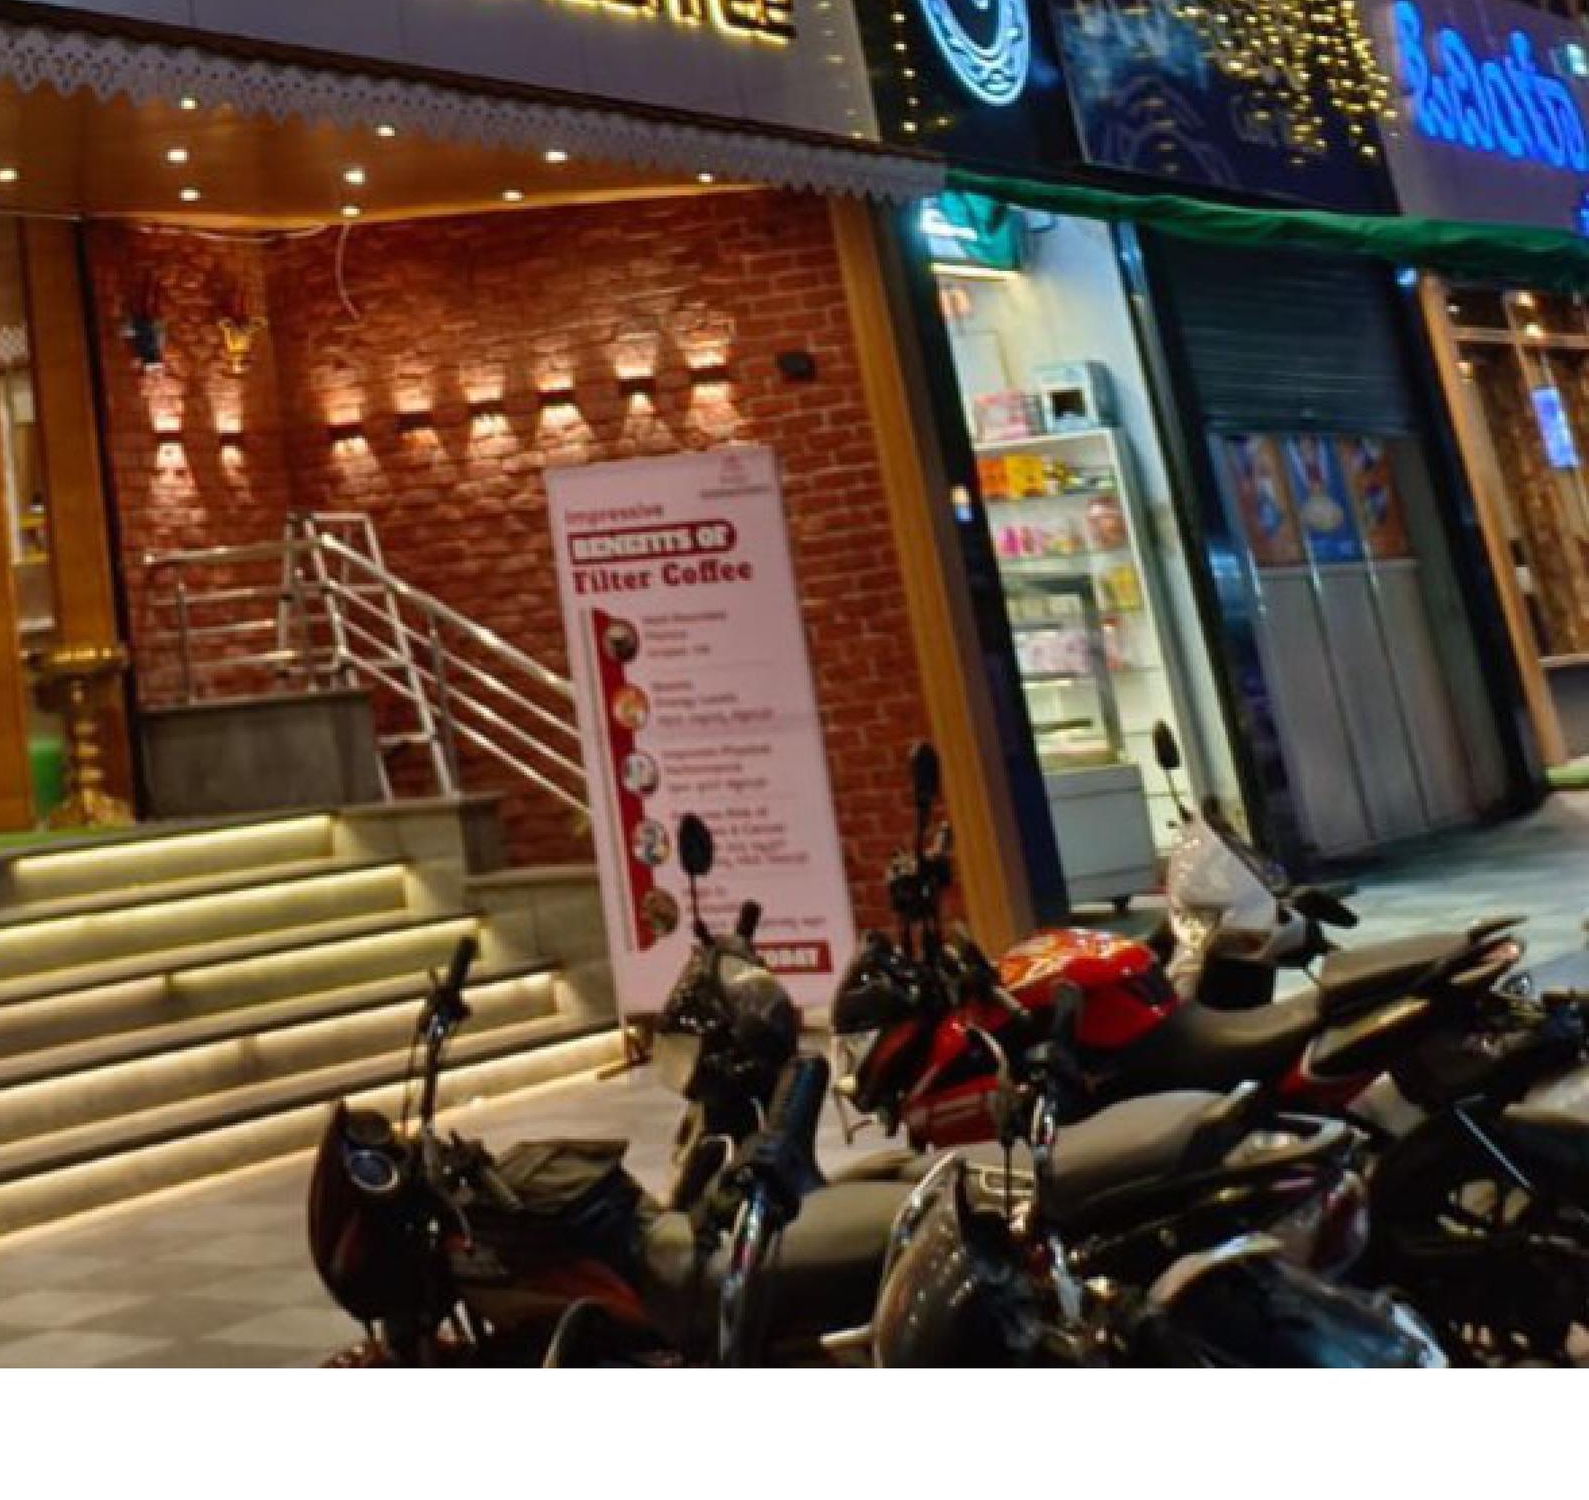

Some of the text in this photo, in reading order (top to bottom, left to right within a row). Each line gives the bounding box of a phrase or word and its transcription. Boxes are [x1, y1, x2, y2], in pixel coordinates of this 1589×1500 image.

[572, 530, 694, 561] BENEFITS
[573, 559, 753, 595] Filter Coffee
